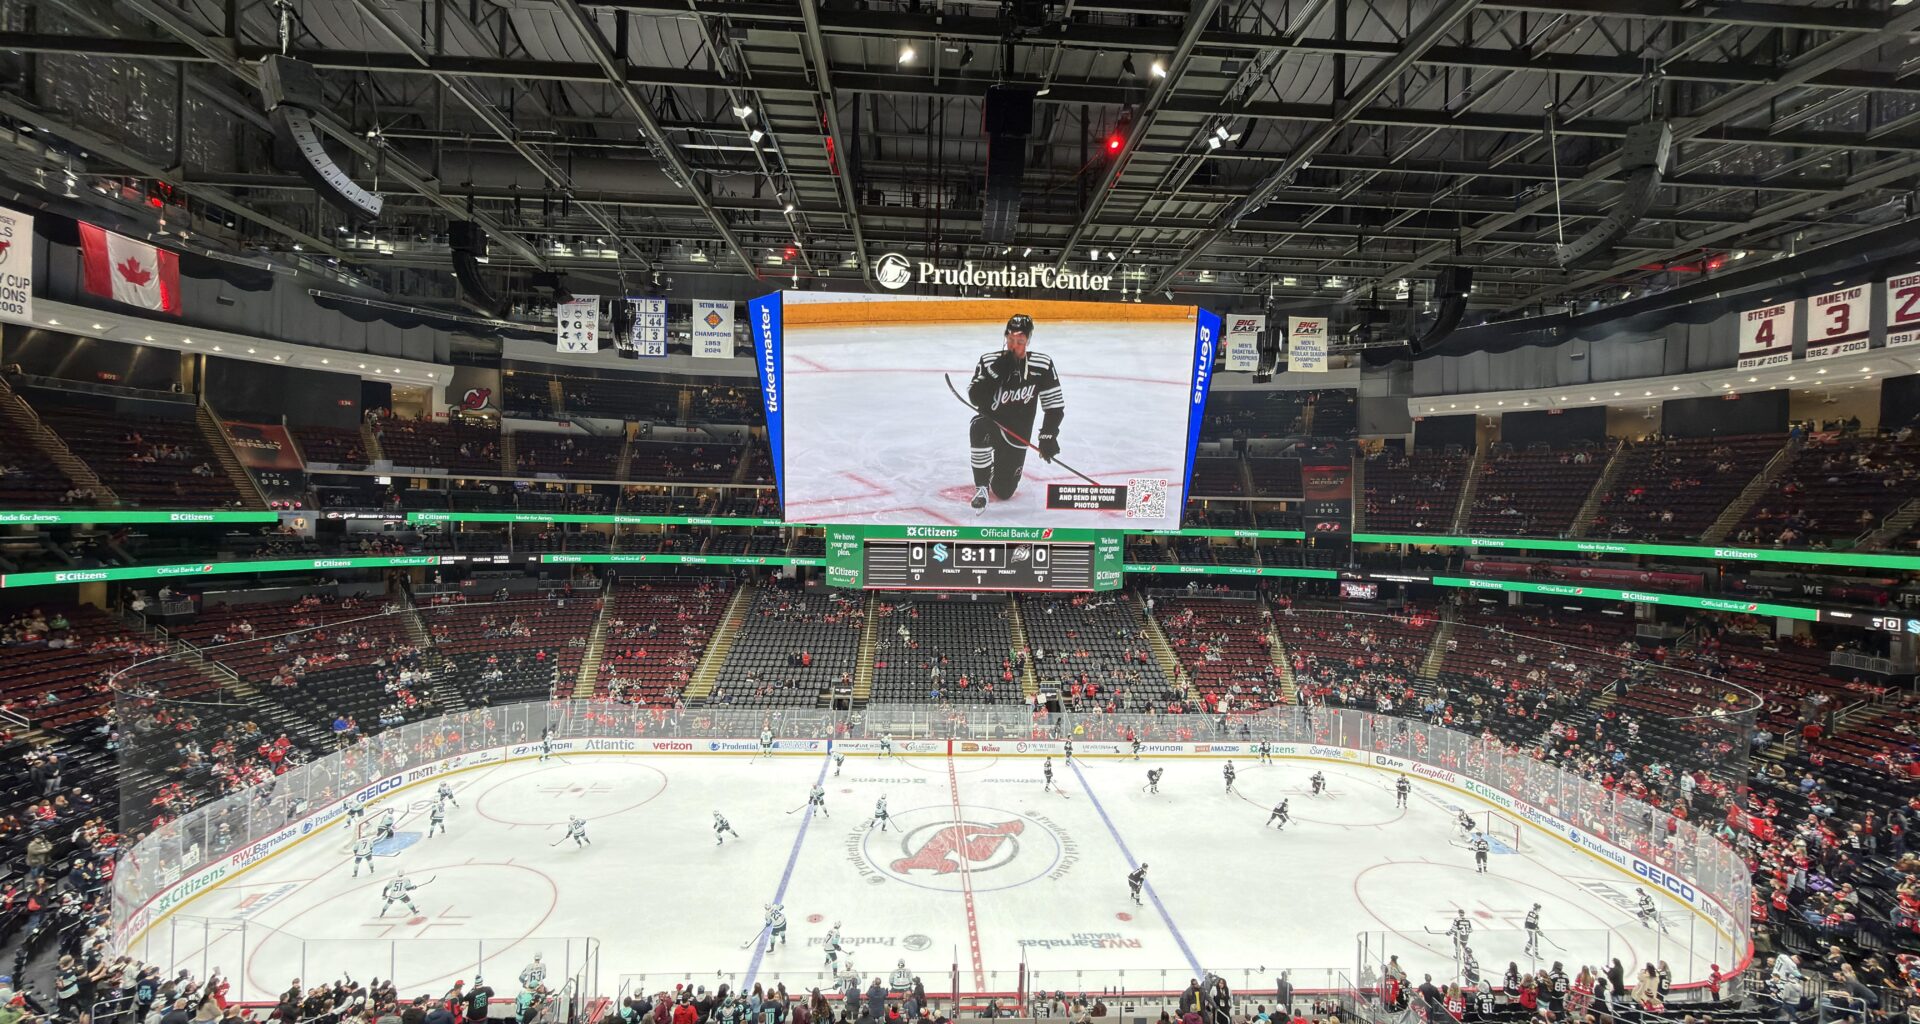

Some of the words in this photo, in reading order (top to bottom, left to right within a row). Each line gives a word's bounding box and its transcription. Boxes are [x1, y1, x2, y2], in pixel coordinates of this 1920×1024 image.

[918, 262, 1038, 288] Prudential
[1041, 267, 1113, 291] Center
[7, 275, 30, 289] CUP
[1817, 288, 1861, 306] DANEYKO
[653, 304, 658, 312] 5
[1747, 305, 1786, 321] STEVENS
[649, 318, 661, 326] 44
[1826, 303, 1850, 336] 3
[653, 332, 658, 340] 3
[1755, 319, 1775, 348] 4
[1890, 335, 1912, 344] 1991
[649, 346, 661, 354] 24
[1807, 348, 1828, 358] 1982
[1842, 342, 1867, 352] 2003
[761, 305, 778, 413] ticketmaster
[1767, 355, 1788, 364] 2005
[1194, 326, 1211, 404] genius
[991, 384, 1036, 411] Jersey
[180, 513, 213, 521] Citizens
[918, 527, 959, 537] Citizens
[981, 529, 1009, 538] Official
[1011, 529, 1029, 538] Bank
[1030, 529, 1039, 538] of
[912, 547, 923, 559] 0
[961, 548, 995, 562] 3:11
[1036, 549, 1046, 562] 0
[1724, 549, 1758, 558] Citizens
[157, 566, 179, 574] Official
[835, 568, 859, 577] Citizens
[67, 572, 107, 581] Citizens
[977, 576, 982, 584] 1
[1803, 585, 1823, 595] WE
[1630, 594, 1659, 602] Citizens
[1702, 600, 1722, 608] Official
[1888, 620, 1896, 628] 0
[585, 740, 635, 750] Atlantic
[653, 742, 692, 750] verizon
[1310, 746, 1341, 756] Surfside
[356, 776, 402, 803] GEICO
[1476, 785, 1511, 807] Citizens
[1514, 799, 1565, 832] RWJBarnabas
[1520, 811, 1541, 824] HEALTH
[232, 827, 297, 866] RWJBarnabas
[362, 842, 368, 850] 7
[1583, 837, 1626, 865] Prudential
[241, 849, 269, 867] HEALTH
[172, 866, 225, 903] Citizens
[1633, 860, 1694, 902] GEICO
[393, 883, 404, 891] 51
[771, 911, 782, 920] 29
[530, 971, 542, 981] 63
[1555, 982, 1567, 991] 86
[1449, 1002, 1462, 1013] 86
[1482, 1004, 1493, 1014] 91
